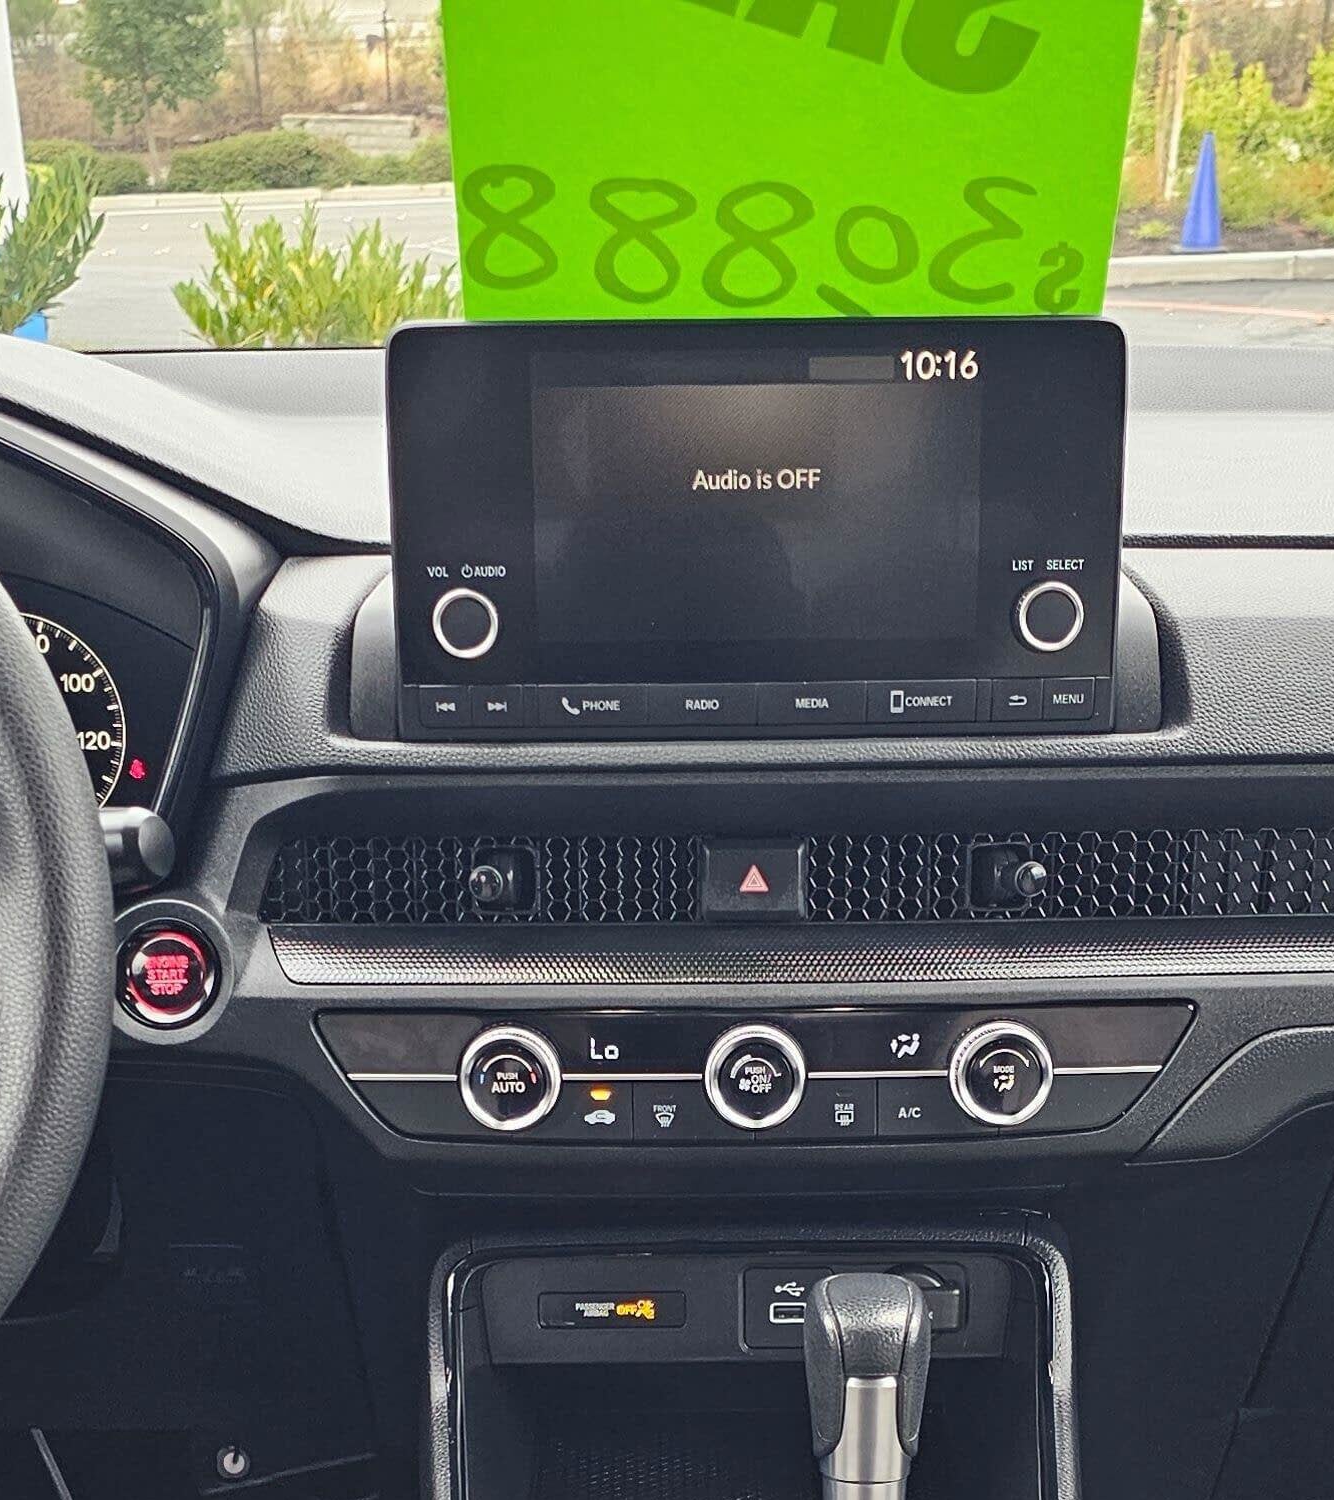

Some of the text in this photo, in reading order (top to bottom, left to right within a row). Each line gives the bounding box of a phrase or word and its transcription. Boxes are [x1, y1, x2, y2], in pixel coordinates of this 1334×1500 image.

[900, 349, 979, 381] 10:16
[692, 467, 821, 491] Audio is OFF
[427, 565, 507, 578] VOL AUDIO
[1012, 558, 1085, 572] LIST SELECT
[59, 673, 96, 693] 100
[582, 699, 621, 712] PHONE
[685, 699, 720, 711] RADIO
[795, 697, 829, 710] MEDIA
[905, 694, 953, 708] CONNECT
[1052, 693, 1085, 705] MENU
[75, 730, 112, 750] 120
[145, 954, 189, 969] ENGINE
[147, 968, 186, 981] START
[150, 983, 184, 996] STOP
[590, 1036, 620, 1060] Lo
[744, 1066, 766, 1075] PUSH
[993, 1065, 1015, 1074] MODE
[496, 1072, 518, 1081] PUSH
[491, 1081, 526, 1094] AUTO
[750, 1084, 772, 1094] OFF
[653, 1104, 677, 1113] FRONT
[834, 1103, 855, 1111] REAR
[898, 1107, 922, 1119] A/C
[616, 1303, 638, 1316] OFF
